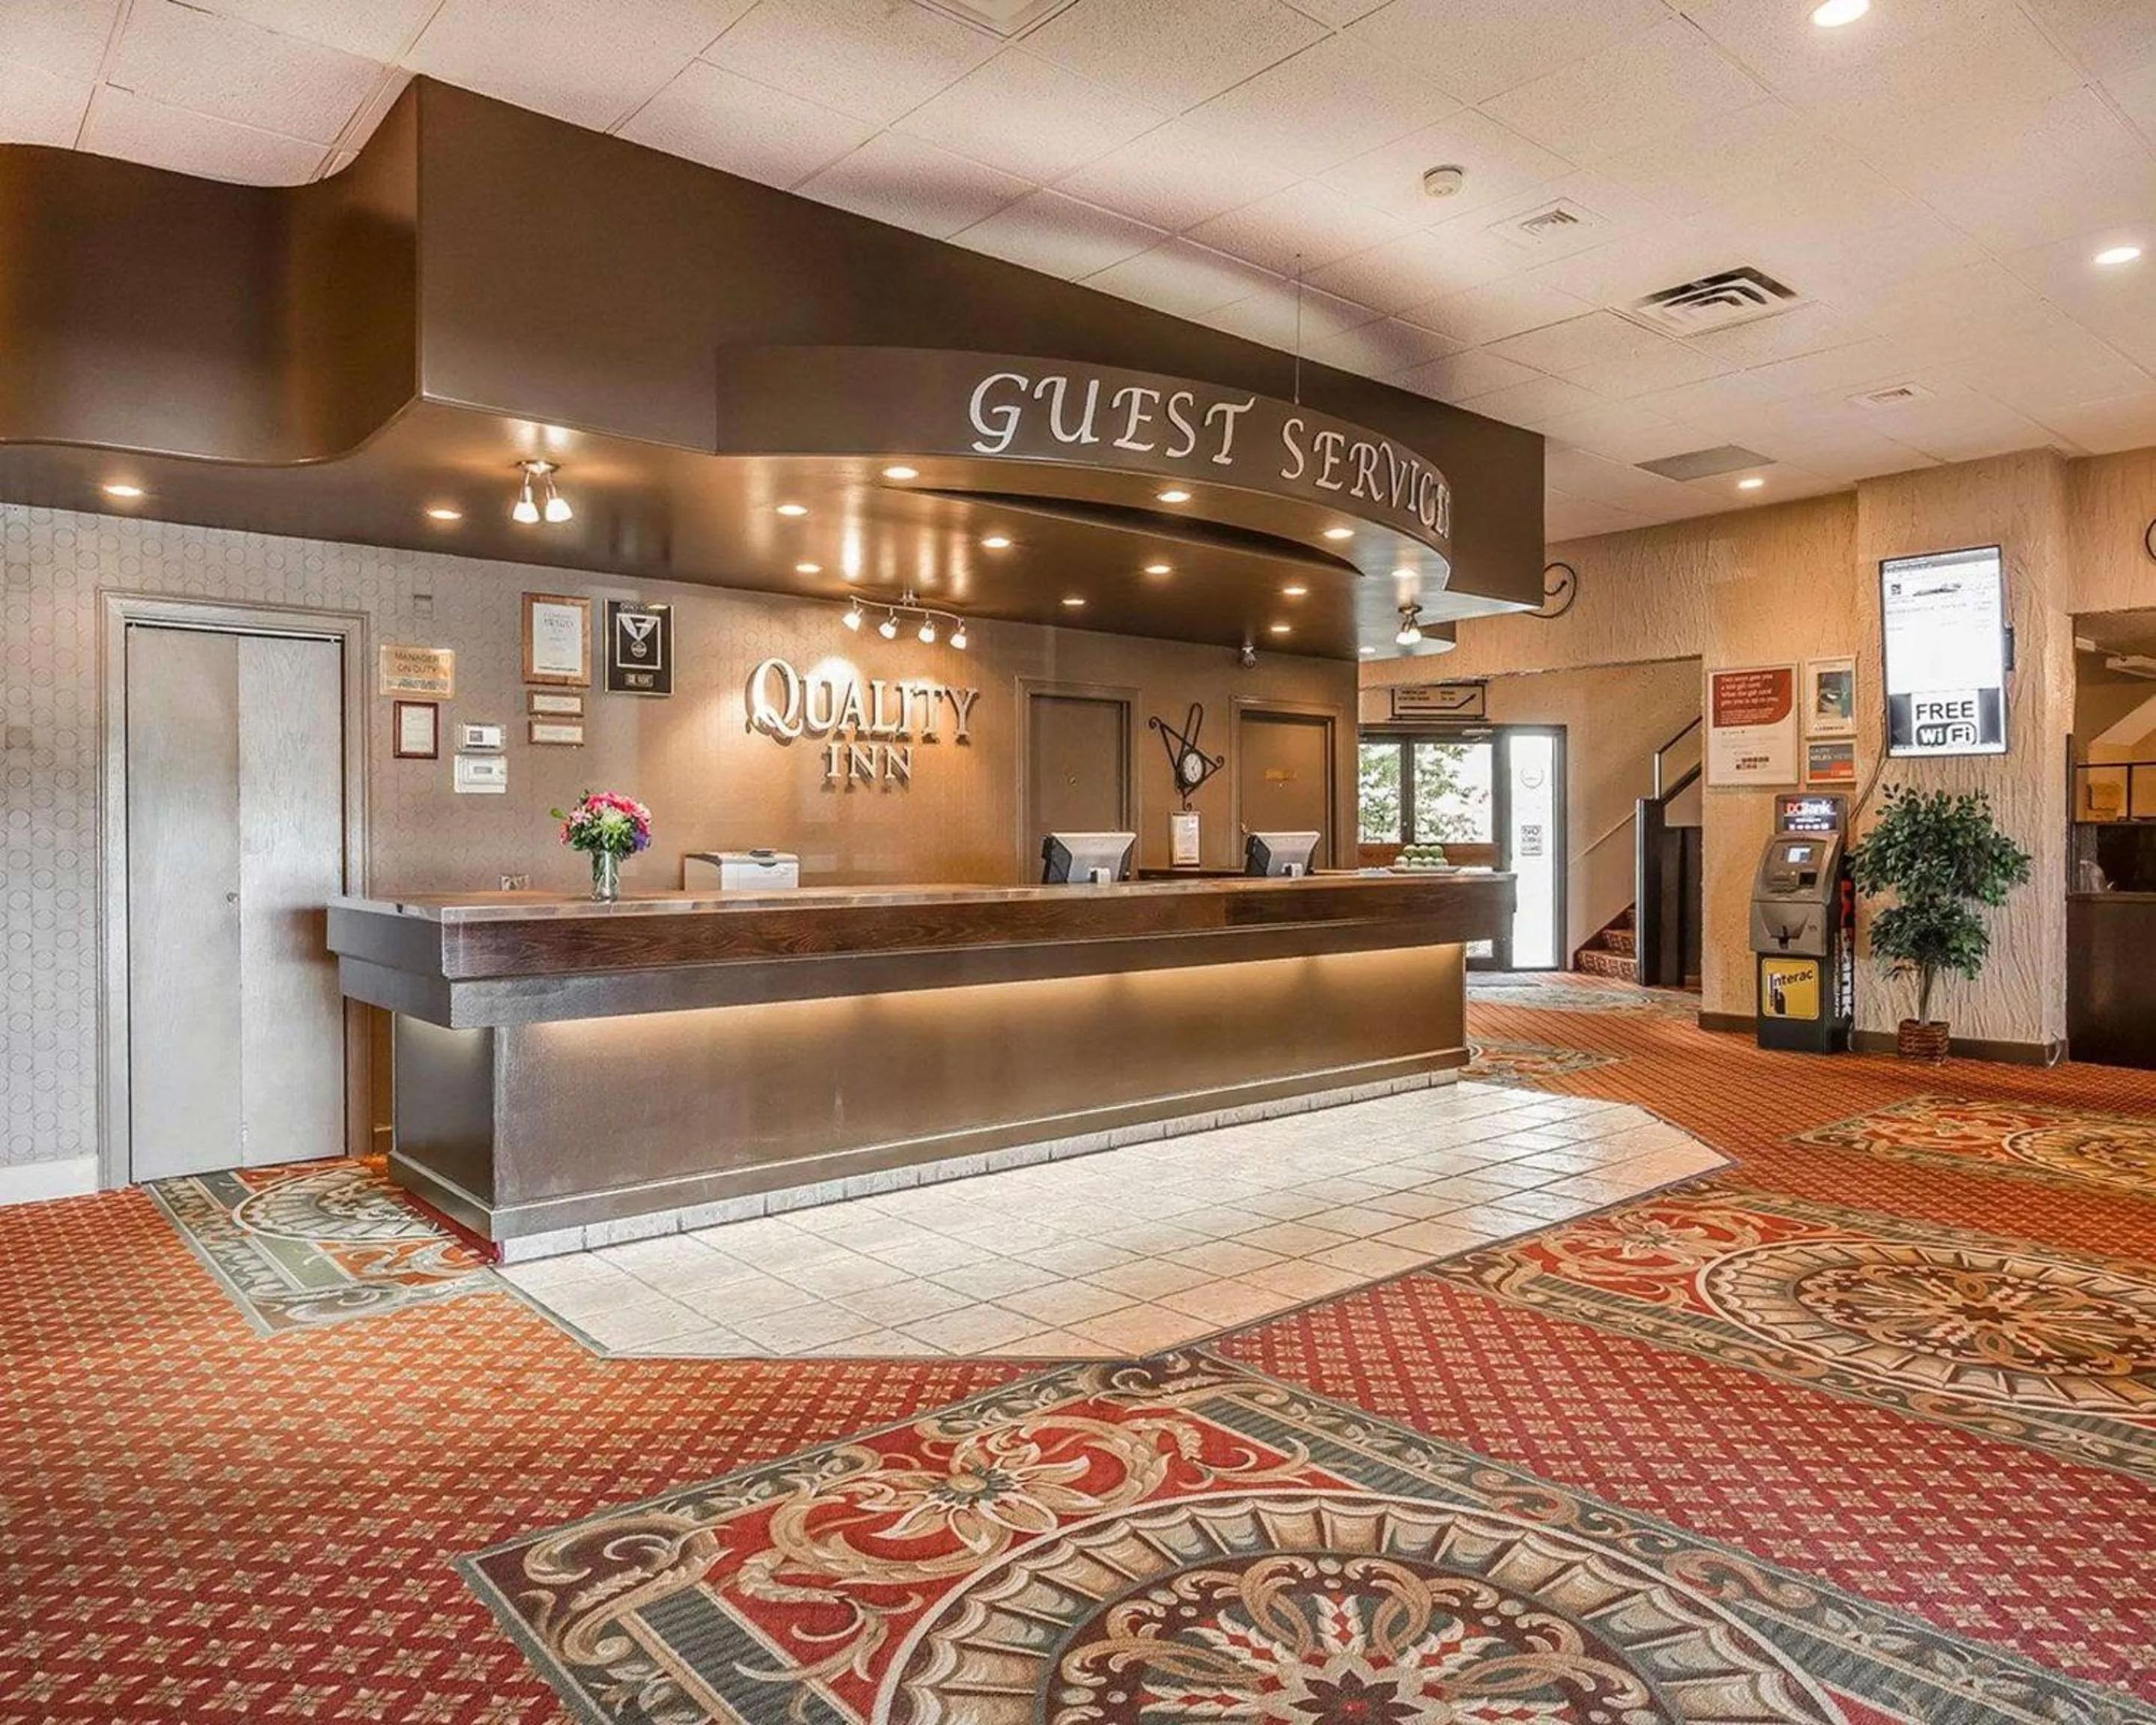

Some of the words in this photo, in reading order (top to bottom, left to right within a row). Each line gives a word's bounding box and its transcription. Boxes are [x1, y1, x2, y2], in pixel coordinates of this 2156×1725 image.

[969, 373, 1255, 466] GUEST
[751, 657, 978, 737] QUALITY
[1916, 700, 1975, 720] FREE
[826, 741, 914, 779] INN
